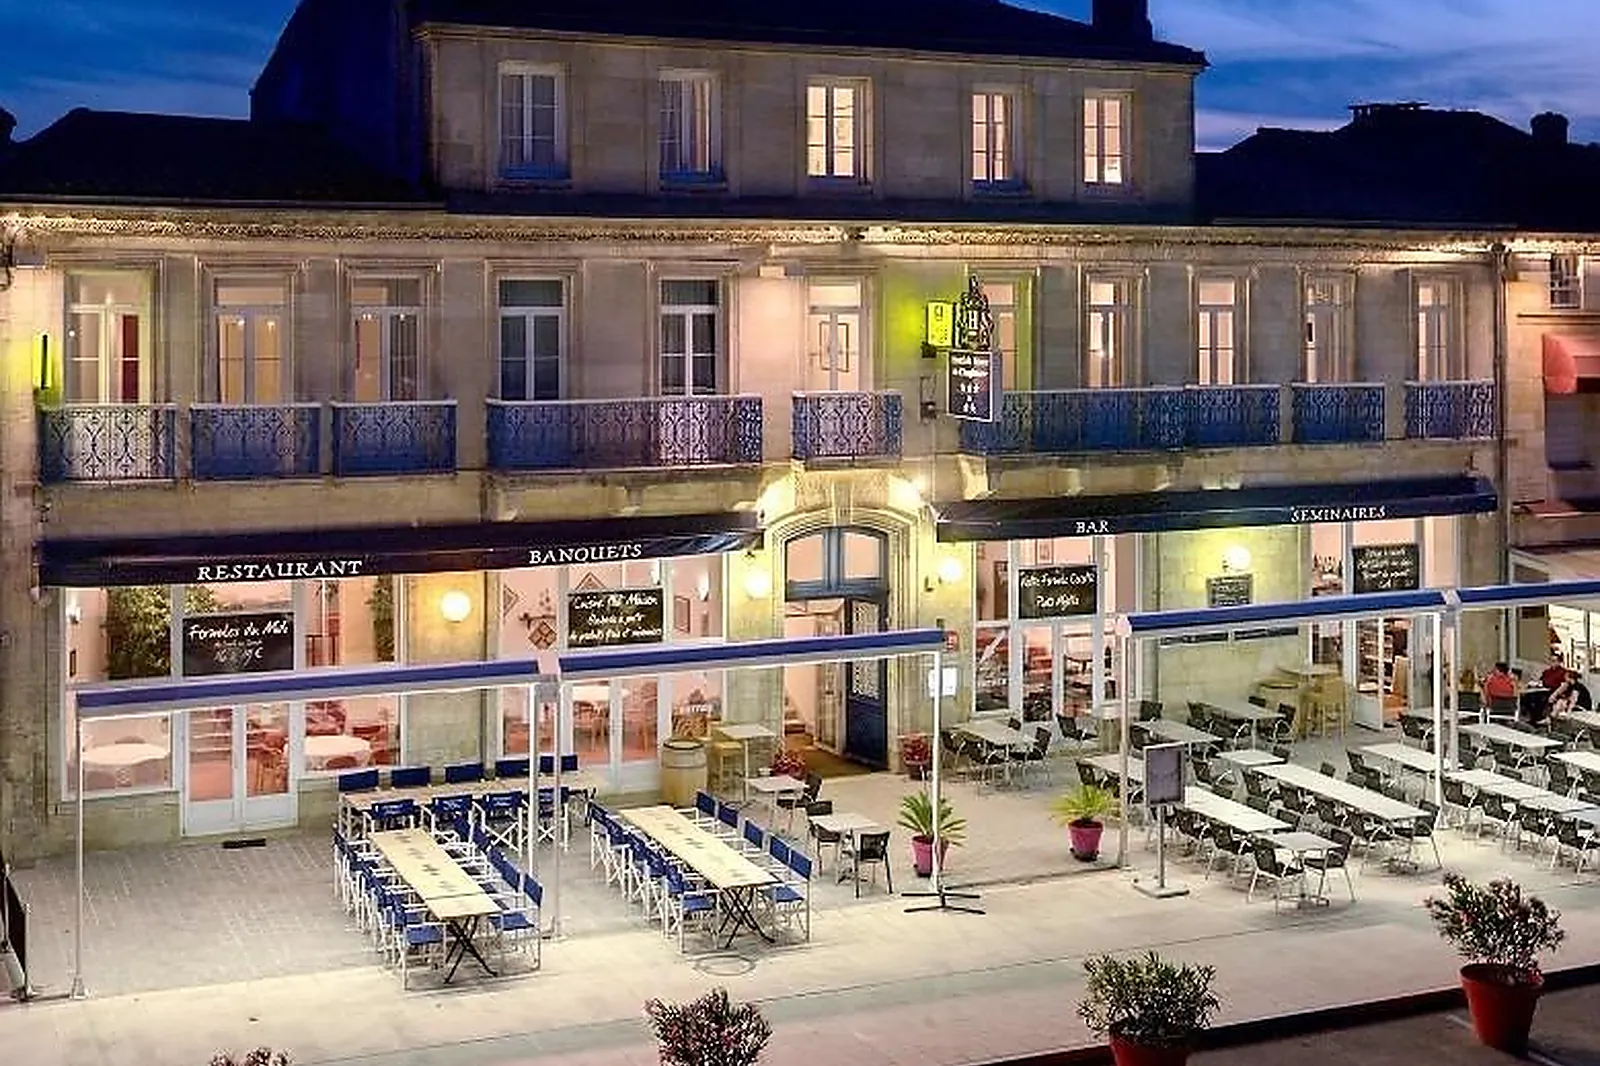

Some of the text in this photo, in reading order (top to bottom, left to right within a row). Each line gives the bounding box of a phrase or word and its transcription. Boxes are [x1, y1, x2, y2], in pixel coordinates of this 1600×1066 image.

[1075, 520, 1110, 534] BAR
[528, 543, 642, 565] BANQUETS
[196, 560, 363, 581] RESTAURANT
